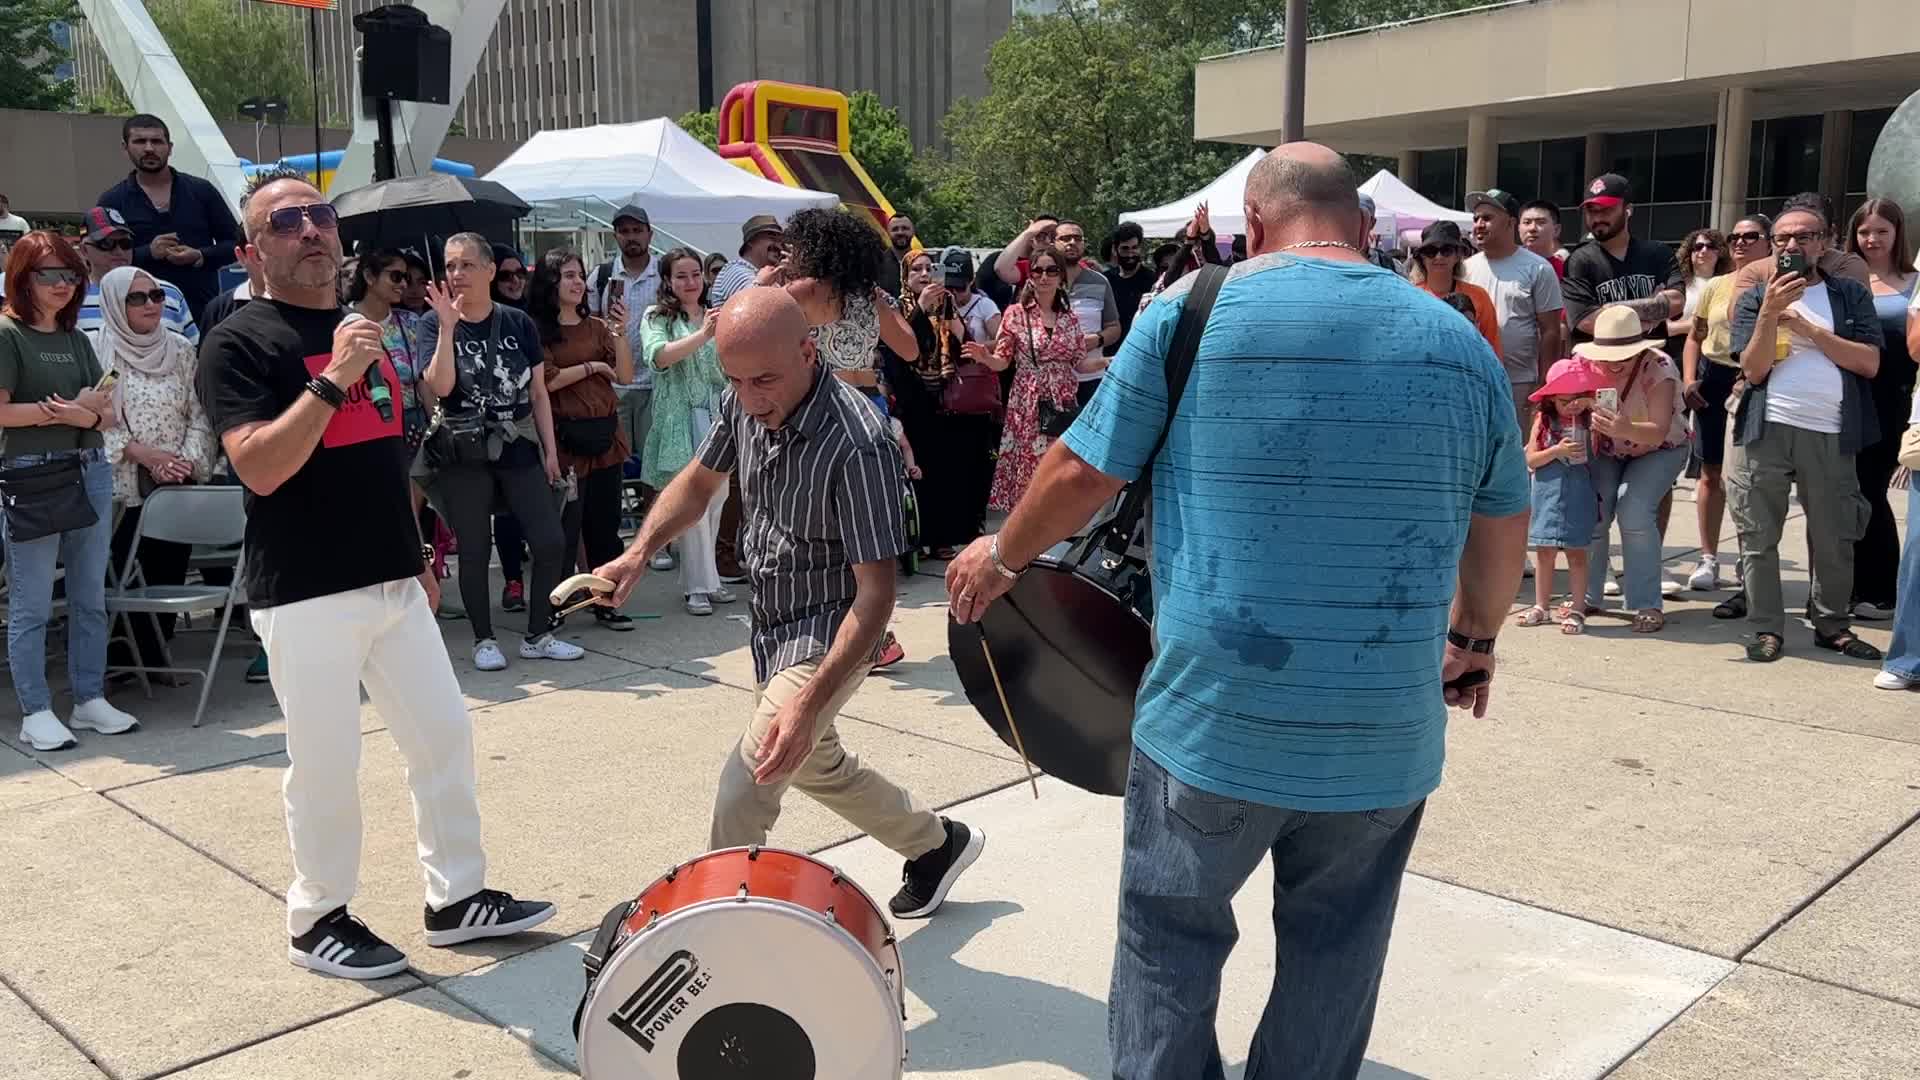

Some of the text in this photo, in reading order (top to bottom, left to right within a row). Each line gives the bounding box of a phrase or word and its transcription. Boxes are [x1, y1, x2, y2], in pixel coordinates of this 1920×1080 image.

[40, 352, 74, 362] GUESS
[645, 967, 712, 1040] POWER BEA
